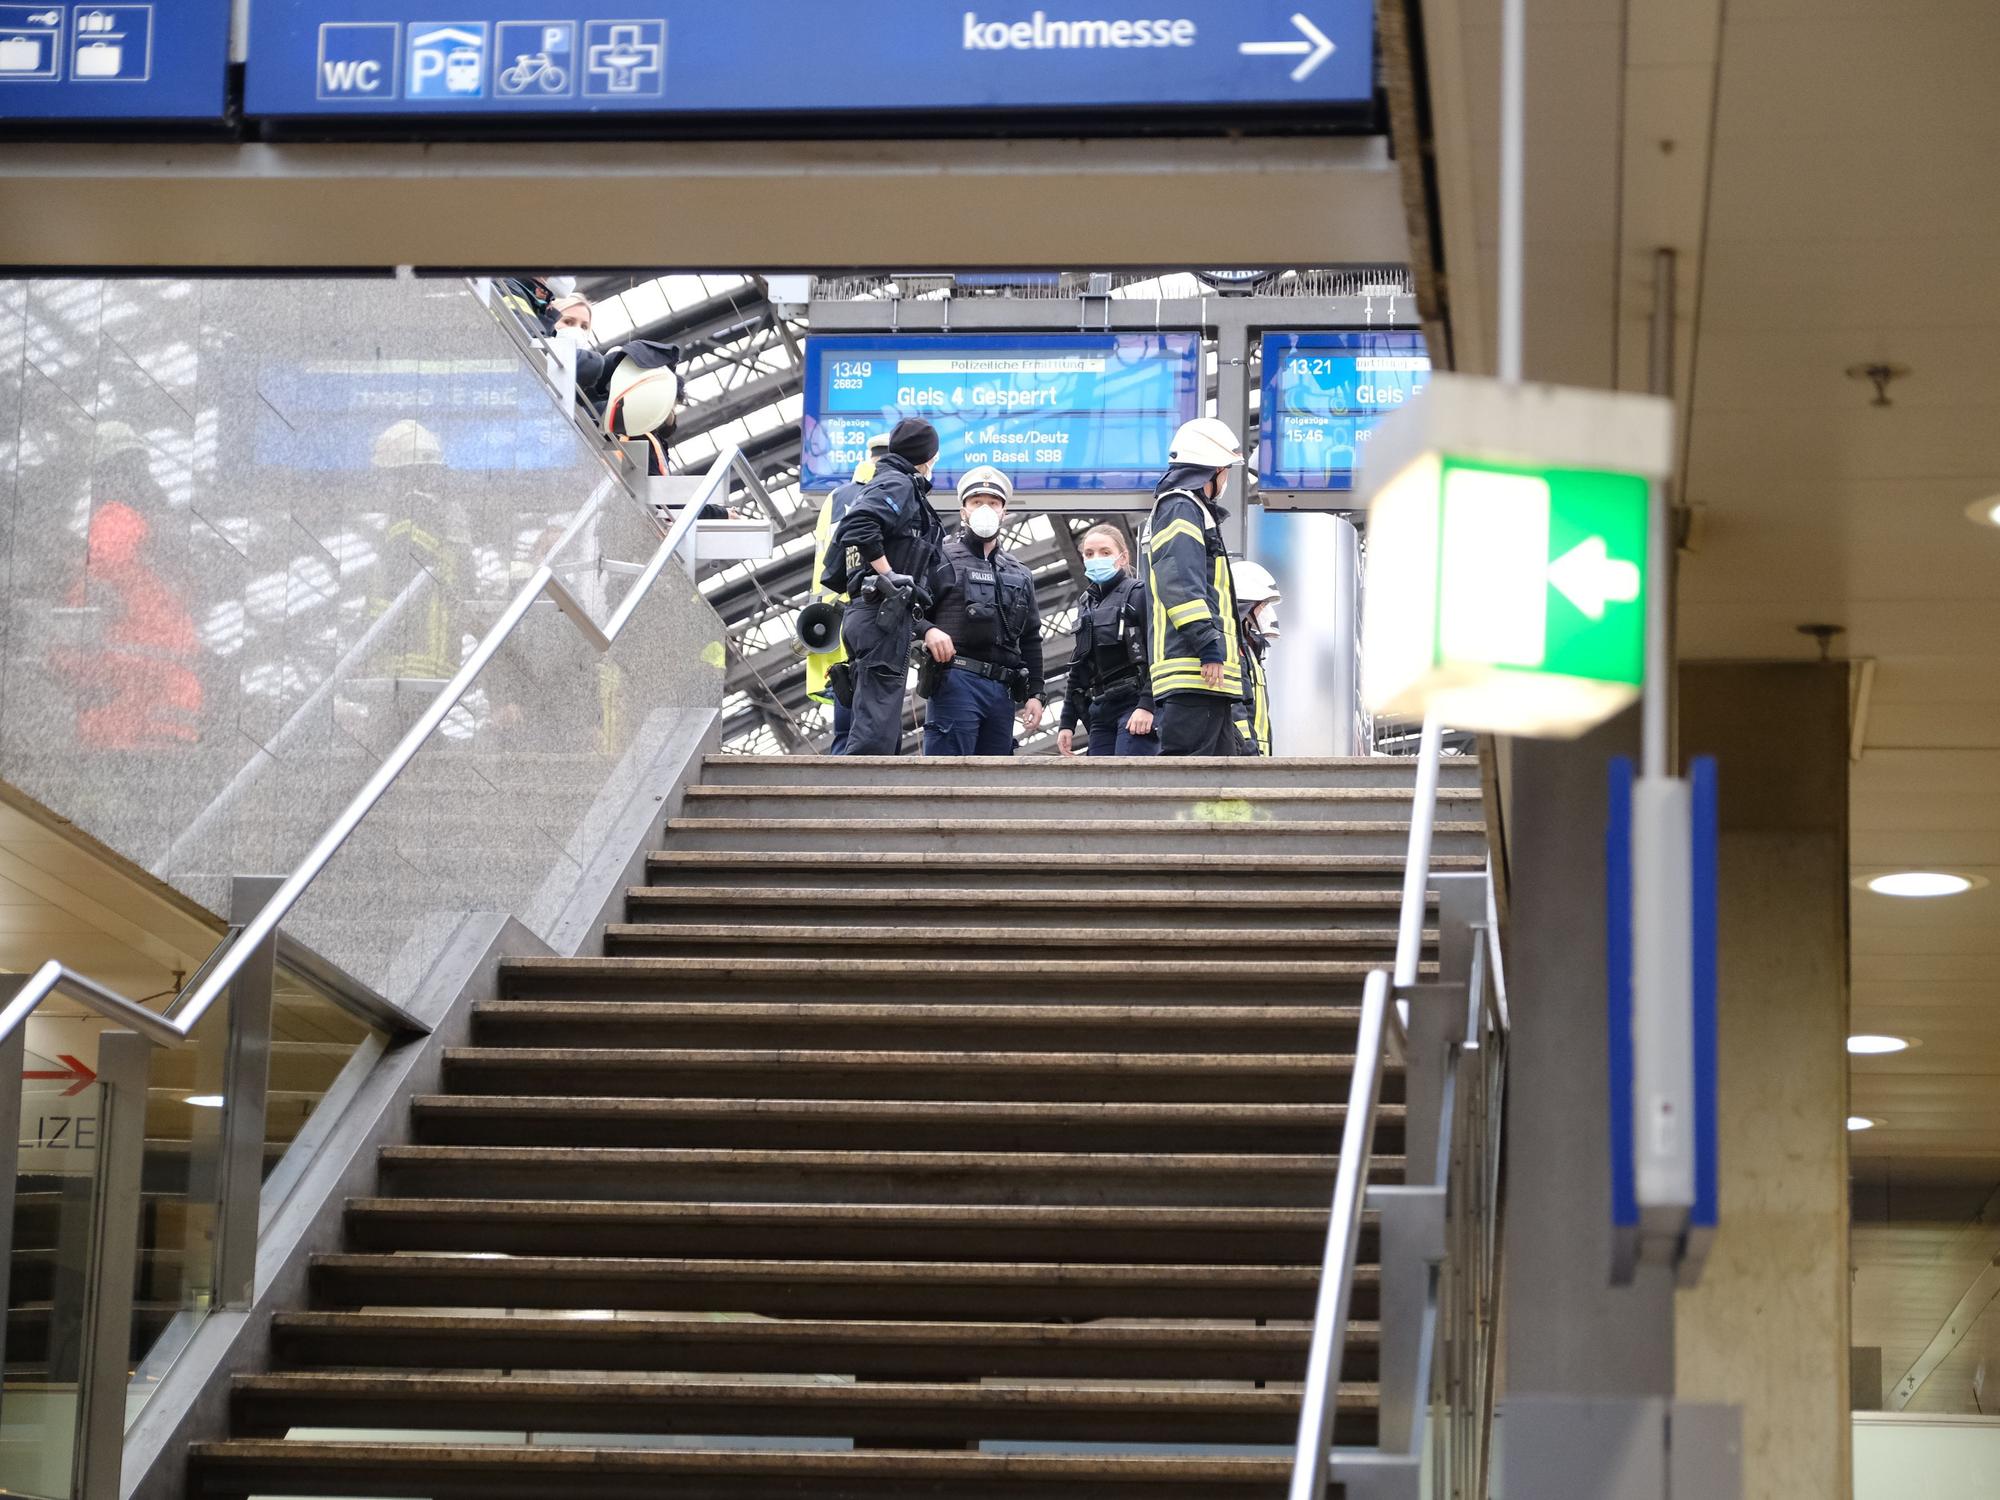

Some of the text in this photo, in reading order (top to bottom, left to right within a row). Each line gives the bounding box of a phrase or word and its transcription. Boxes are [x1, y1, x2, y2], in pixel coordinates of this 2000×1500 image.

[963, 10, 1196, 51] koelnmesse
[324, 60, 380, 91] WC
[832, 362, 871, 377] 13:49
[1288, 359, 1332, 375] 13:21
[833, 378, 863, 389] 26823
[897, 386, 1057, 409] Gleis 4 Gesperrt
[1356, 385, 1404, 403] Gleis
[829, 432, 865, 445] 15:28
[964, 431, 1069, 444] K Messe/Deutz
[1286, 429, 1323, 442] 15:46
[829, 450, 864, 463] 15:04
[964, 450, 1062, 463] von Basel SBB
